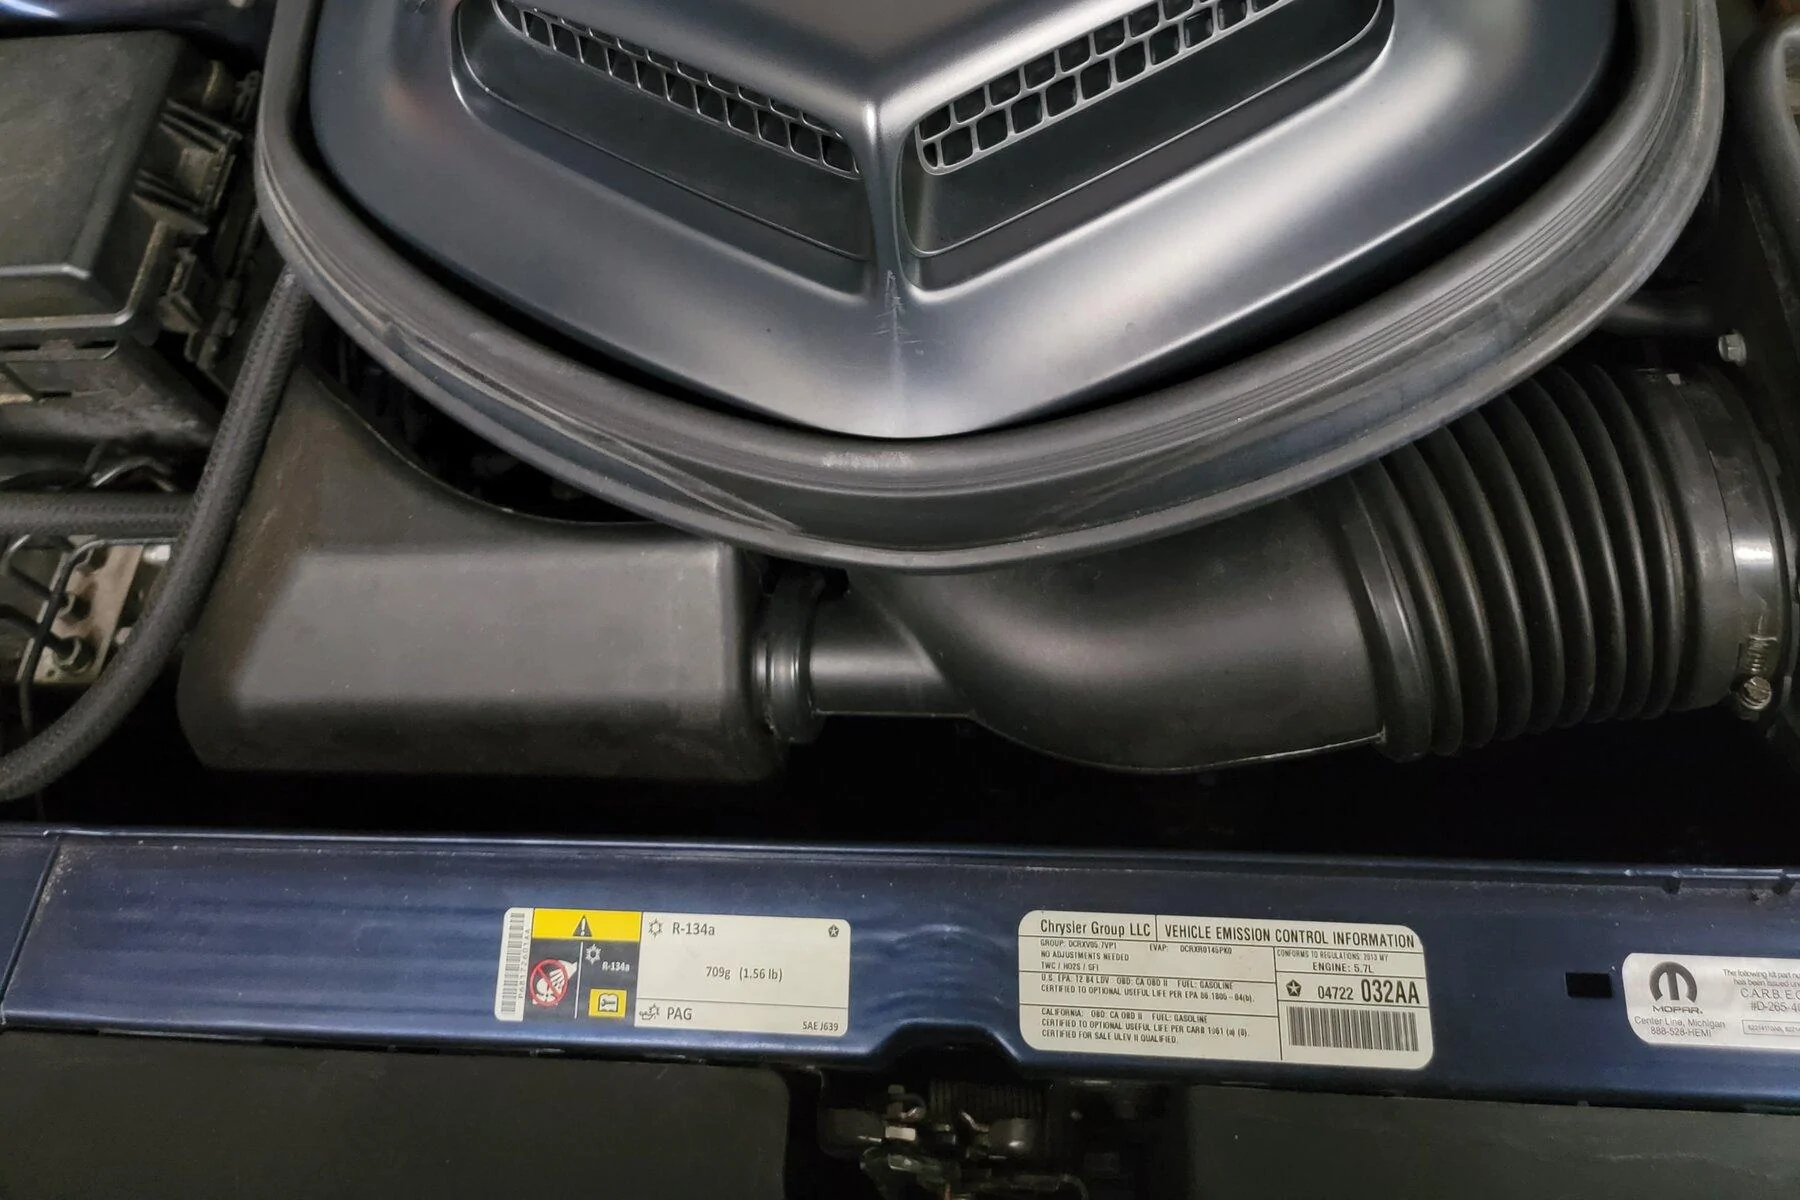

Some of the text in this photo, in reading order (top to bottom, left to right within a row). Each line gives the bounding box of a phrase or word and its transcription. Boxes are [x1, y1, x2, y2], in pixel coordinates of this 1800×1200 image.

[672, 922, 715, 936] R-134a
[1040, 919, 1150, 938] Chrysler Group LLC
[1165, 924, 1414, 948] VEHICLE EMISSION CONTROL INFORMATION
[1040, 950, 1129, 961] NO ADJUSTMENTS NEEDED
[1277, 949, 1309, 958] CONFORMS
[1311, 950, 1318, 958] TO
[602, 961, 630, 972] R-134a
[1041, 962, 1056, 970] TWC
[1312, 962, 1374, 974] ENGINE: 5.7L
[1722, 968, 1736, 976] The
[706, 966, 783, 982] 709g (1.56 lb)
[1136, 978, 1144, 986] CA
[1178, 980, 1197, 988] FUEL:
[1200, 980, 1234, 990] GASOLINE
[1088, 986, 1121, 995] OPTIONAL
[1124, 988, 1149, 996] USEFUL
[1152, 990, 1166, 998] LIFE
[1170, 990, 1182, 998] PER
[1185, 991, 1198, 999] EPA
[1318, 978, 1420, 1004] 04722 032AA
[667, 1007, 692, 1021] PAG
[1110, 1011, 1119, 1019] CA
[1152, 1013, 1172, 1022] FUEL:
[1174, 1014, 1208, 1024] GASOLINE
[802, 1020, 839, 1032] SAE J639
[1042, 1018, 1076, 1028] CERTIFIED
[1079, 1020, 1088, 1028] TO
[1090, 1021, 1122, 1030] OPTIONAL
[1126, 1023, 1150, 1032] USEFUL
[1154, 1024, 1168, 1032] LIFE
[1171, 1025, 1184, 1033] PER
[1186, 1026, 1204, 1034] CARB
[1634, 1016, 1726, 1029] Center Line, Michigan
[1042, 1030, 1076, 1038] CERTIFIED
[1079, 1031, 1092, 1040] FOR
[1094, 1032, 1111, 1040] SALE
[1114, 1033, 1131, 1041] ULEV
[1650, 1026, 1712, 1038] 888-528-HEMI
